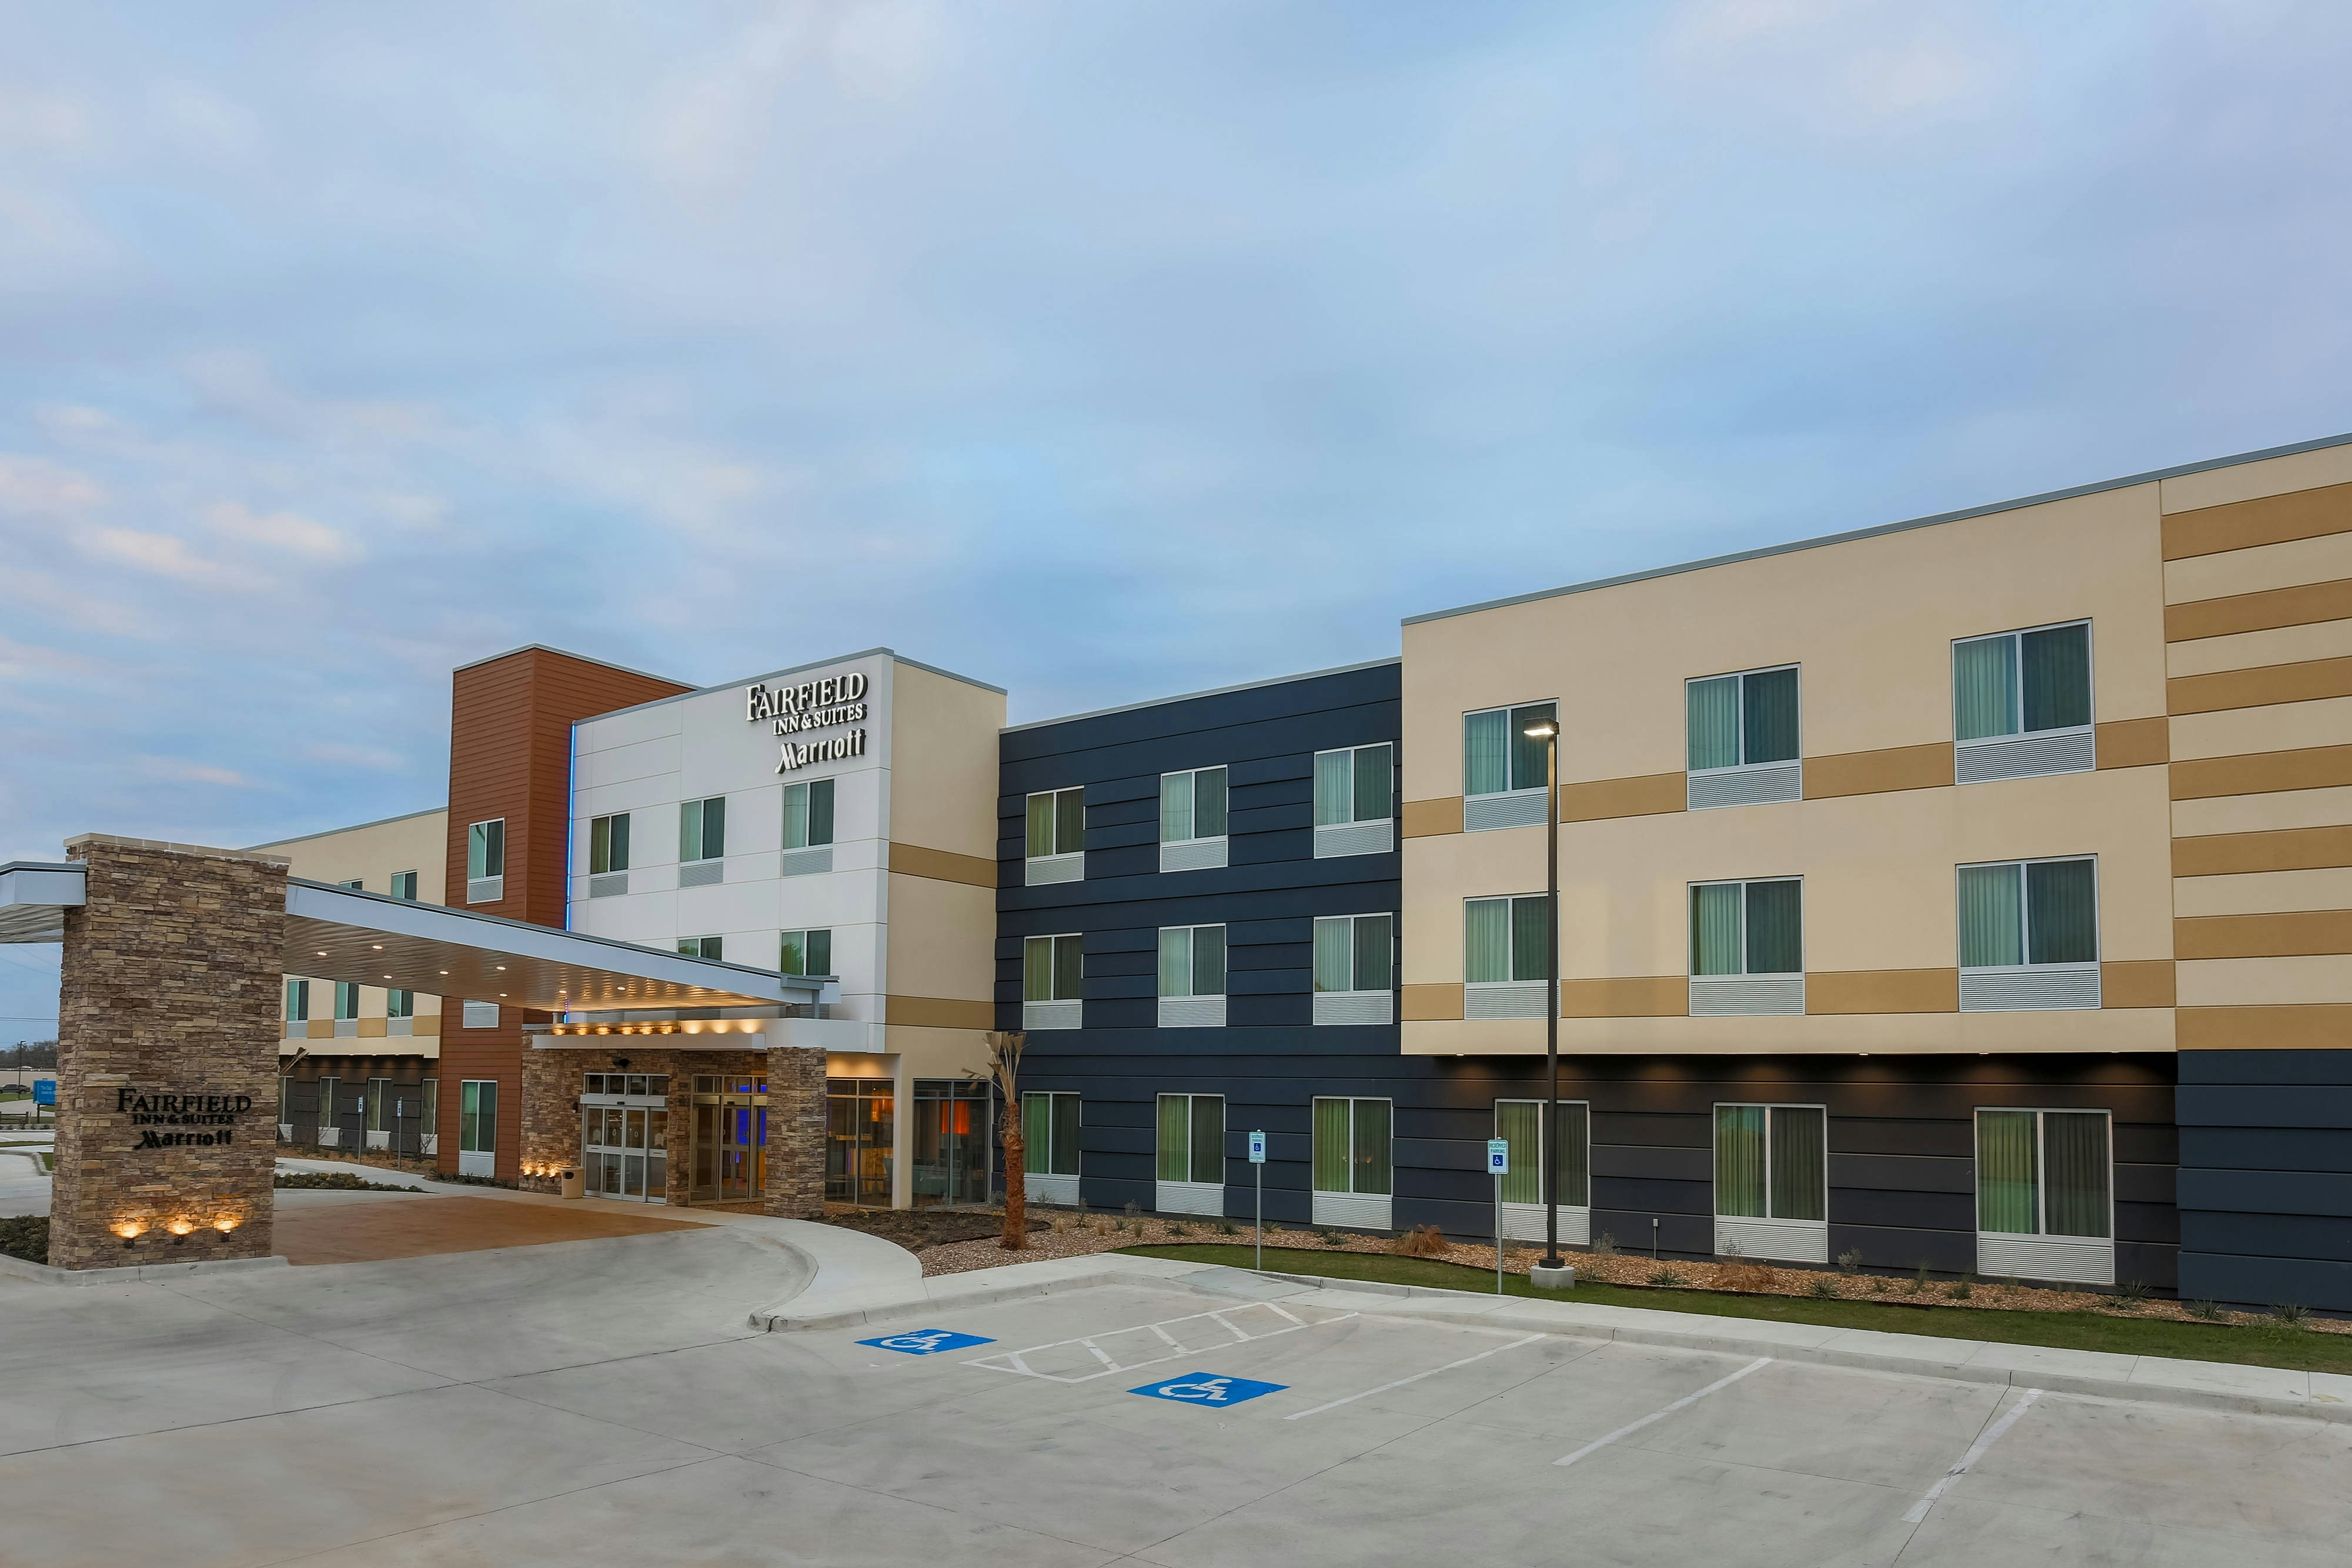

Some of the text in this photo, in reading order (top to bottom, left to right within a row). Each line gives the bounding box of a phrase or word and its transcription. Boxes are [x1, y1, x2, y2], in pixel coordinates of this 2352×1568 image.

[745, 673, 867, 721] FAIRFIELD
[774, 728, 866, 774] Marriott
[117, 1088, 252, 1114] FAIRFIELD
[132, 1114, 165, 1124] INN
[182, 1114, 234, 1124] SUITES
[132, 1130, 232, 1149] Marriott
